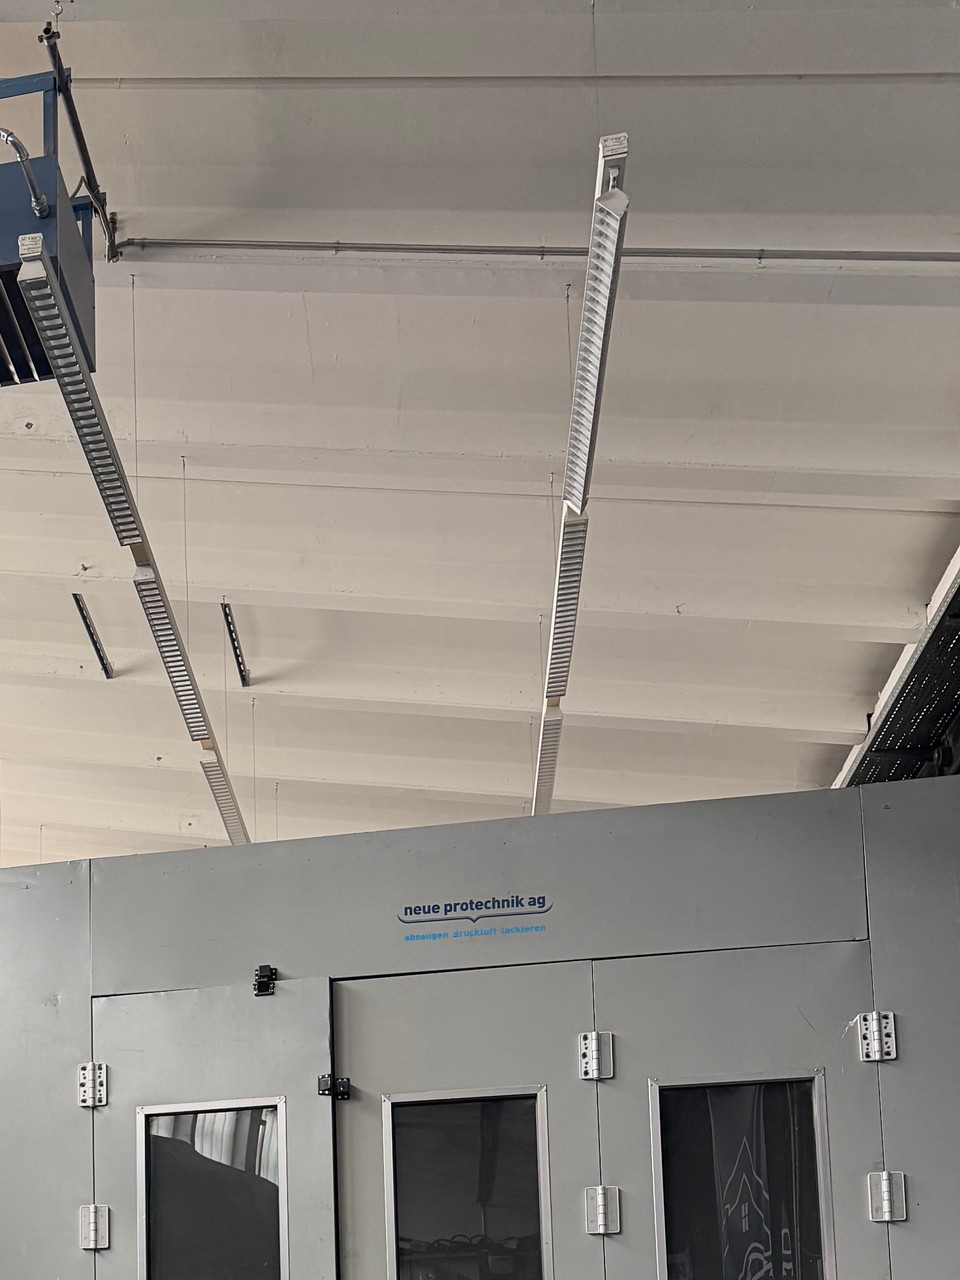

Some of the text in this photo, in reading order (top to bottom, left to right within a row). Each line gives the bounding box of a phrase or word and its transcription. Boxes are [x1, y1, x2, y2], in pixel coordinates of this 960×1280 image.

[404, 895, 546, 916] neue protechnik ag
[404, 924, 546, 942] absaugen druckluft lackieren
